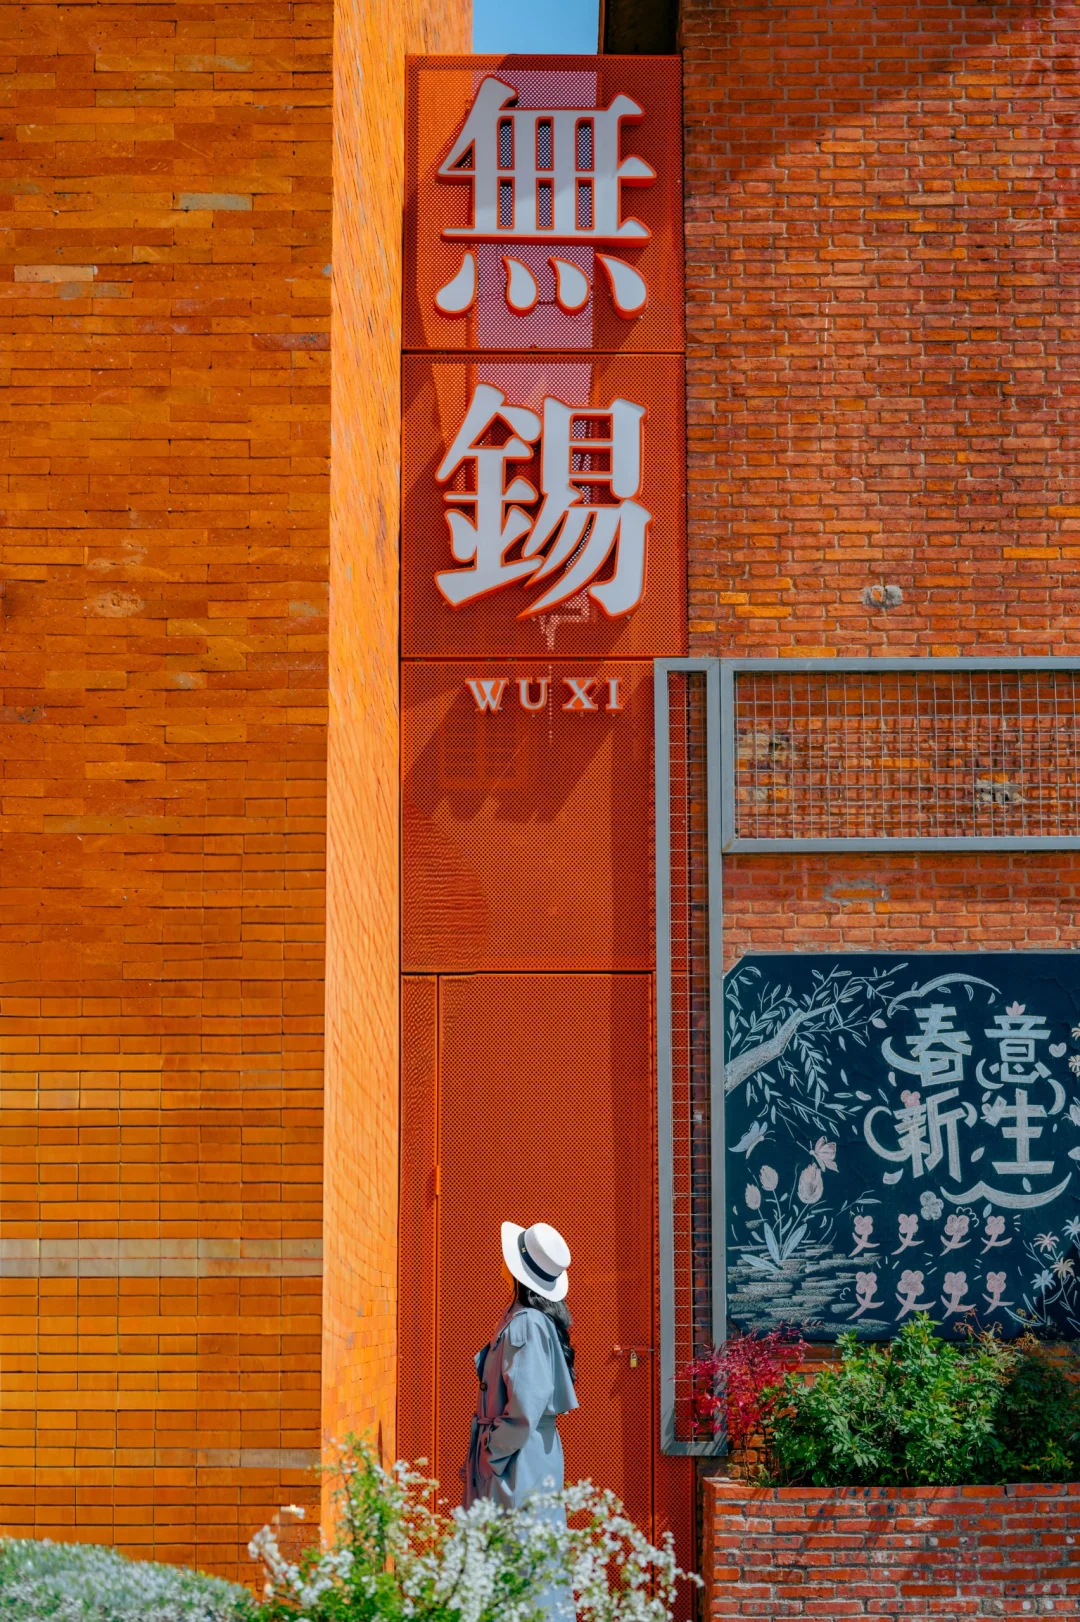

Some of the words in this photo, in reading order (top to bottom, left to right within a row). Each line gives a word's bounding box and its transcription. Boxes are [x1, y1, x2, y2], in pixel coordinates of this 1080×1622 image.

[436, 75, 657, 619] 無錫
[465, 677, 624, 714] WUXI
[883, 1003, 1052, 1087] 春意
[866, 1087, 1055, 1182] 新生
